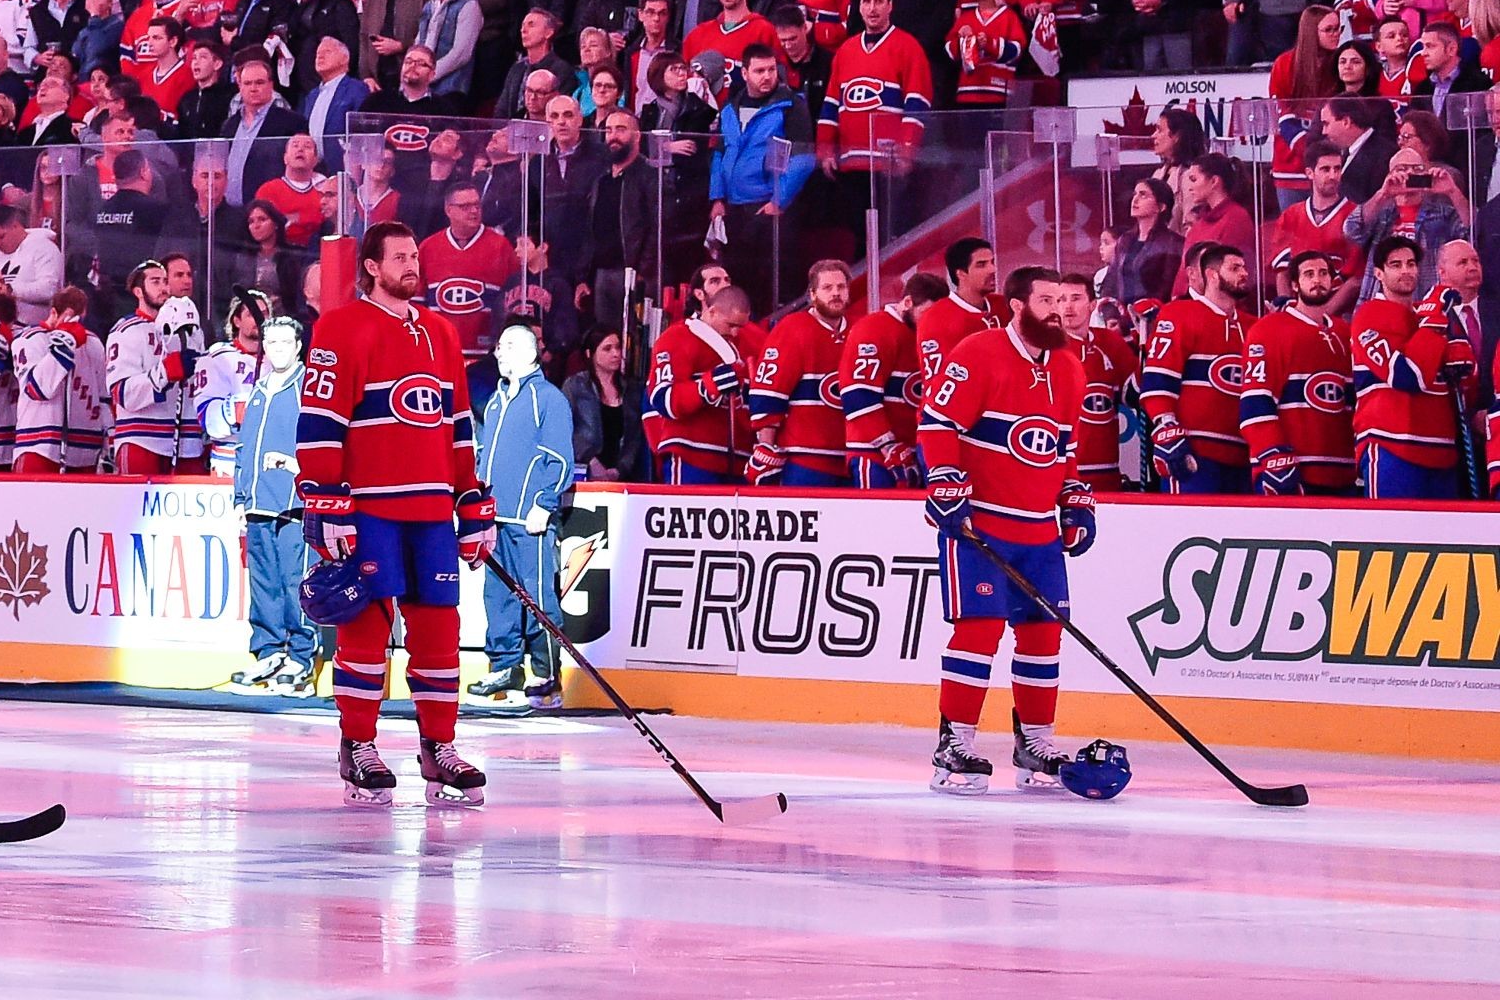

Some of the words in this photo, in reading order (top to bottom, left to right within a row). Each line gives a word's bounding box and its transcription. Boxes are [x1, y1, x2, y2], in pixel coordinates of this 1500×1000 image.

[1165, 80, 1216, 96] MOLSON
[1367, 338, 1391, 367] 67
[304, 368, 336, 399] 26
[655, 363, 674, 386] 14
[755, 362, 778, 385] 92
[853, 359, 880, 380] 27
[142, 491, 234, 518] MOLSO
[304, 499, 351, 511] CCM
[644, 506, 819, 542] GATORADE
[65, 527, 249, 621] CANADI
[631, 548, 940, 660] FROST
[1127, 537, 1500, 676] SUBWAY
